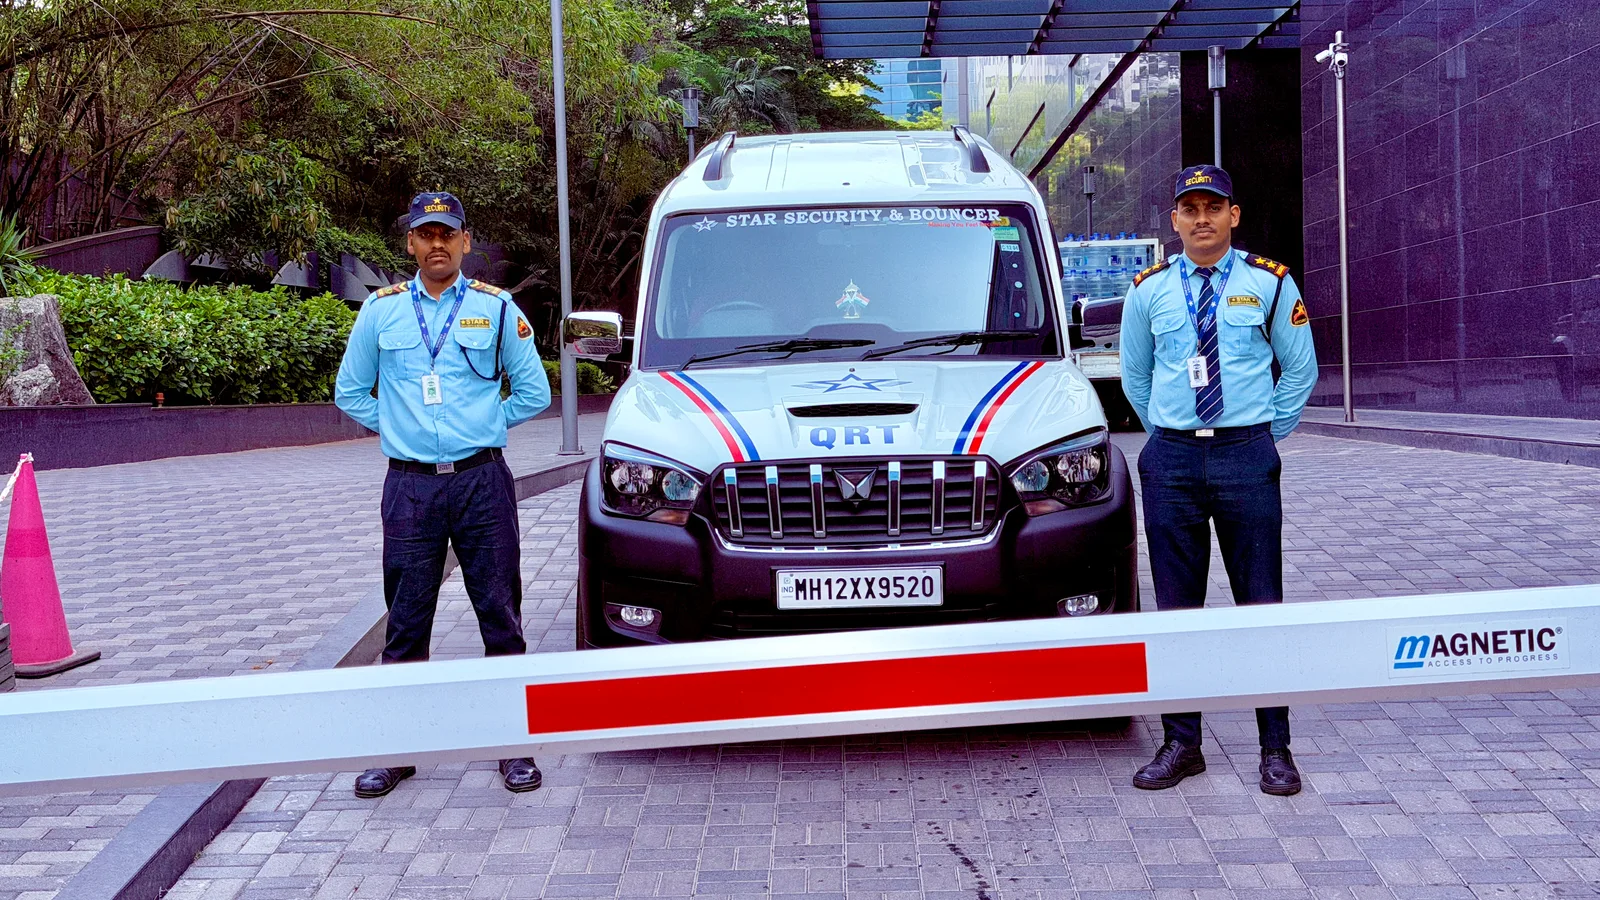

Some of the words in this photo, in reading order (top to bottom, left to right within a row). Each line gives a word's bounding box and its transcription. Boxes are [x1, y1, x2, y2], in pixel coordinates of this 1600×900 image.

[1185, 176, 1212, 186] SECURITY
[424, 204, 450, 213] SECURITY
[726, 213, 777, 228] STAR
[784, 209, 882, 225] SECURITY
[889, 209, 904, 221] &
[909, 208, 1002, 222] BOUNCER
[810, 425, 900, 450] QRT
[795, 575, 934, 601] MH12XX9520
[1427, 658, 1472, 668] ACCESS
[1479, 657, 1493, 665] TO
[1498, 653, 1559, 664] PROGRESS
